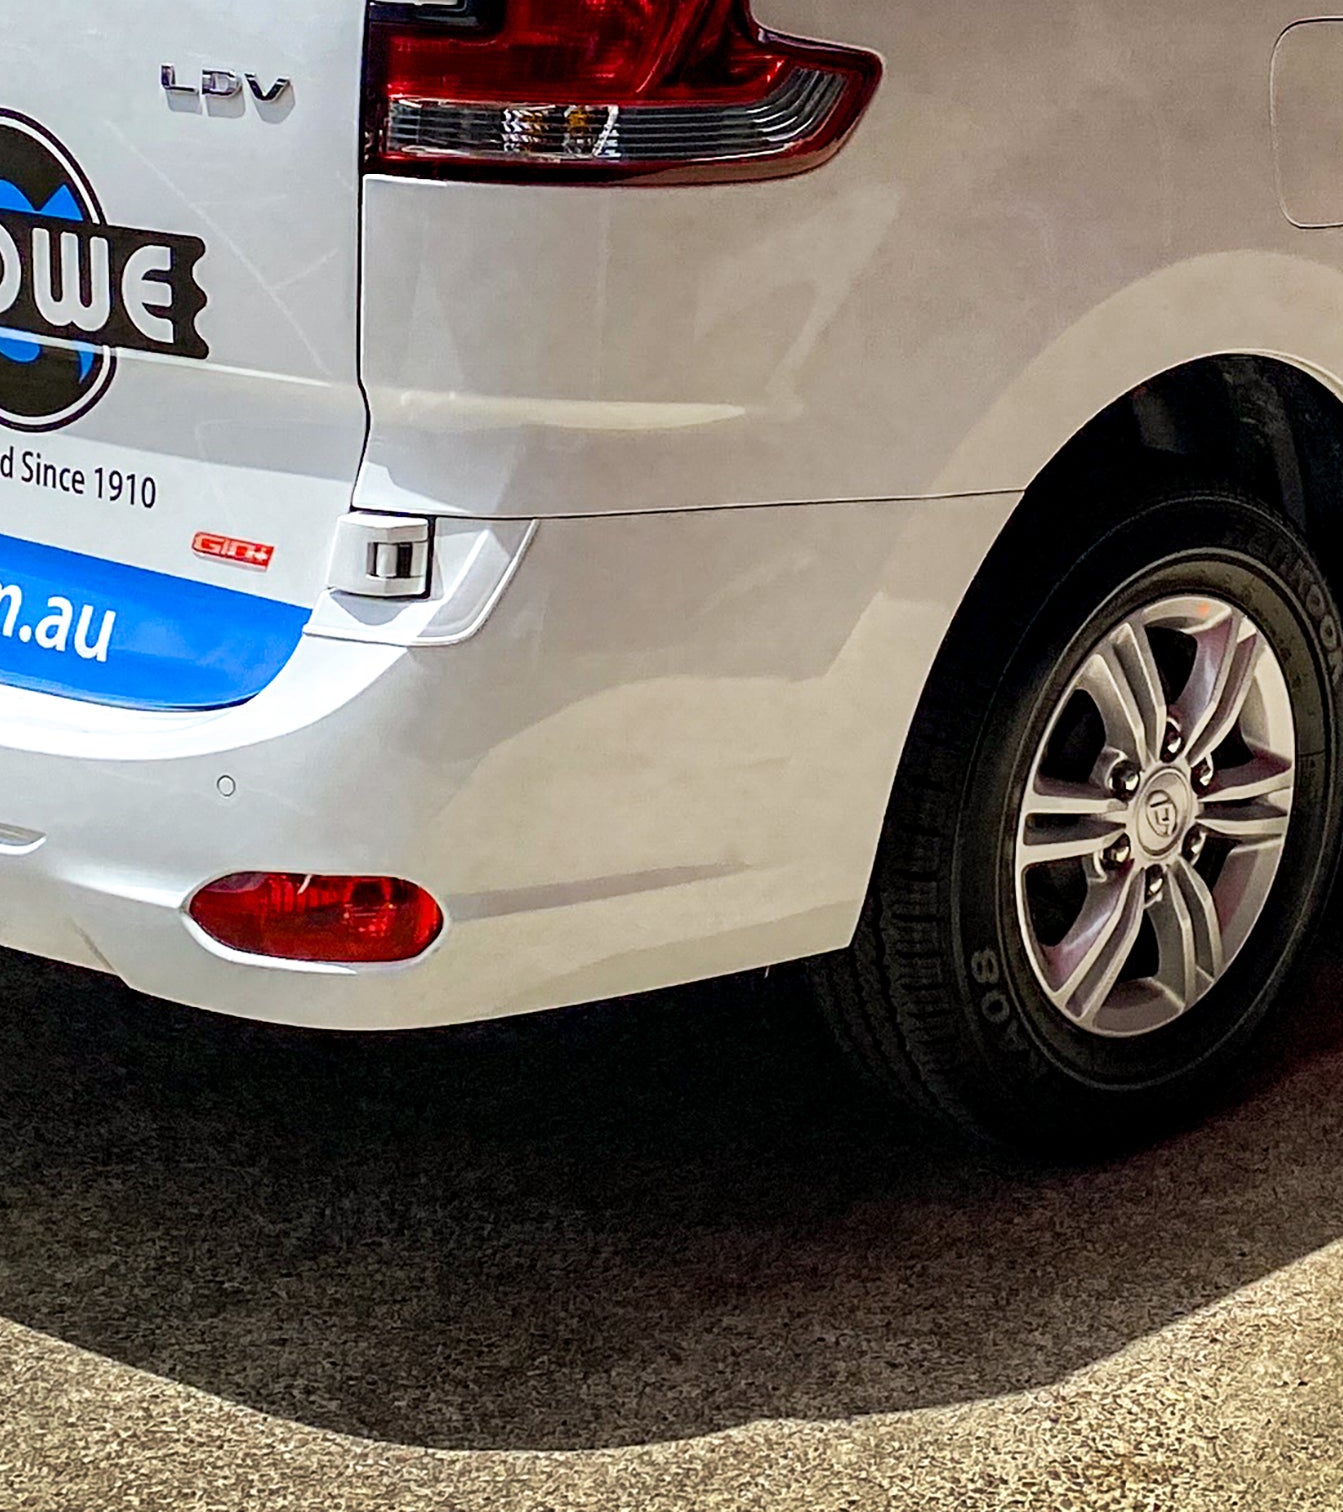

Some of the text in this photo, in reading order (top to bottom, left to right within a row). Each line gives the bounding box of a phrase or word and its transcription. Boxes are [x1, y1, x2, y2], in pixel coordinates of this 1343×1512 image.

[160, 62, 292, 103] LDV
[21, 450, 86, 495] Since
[94, 466, 156, 509] 1910
